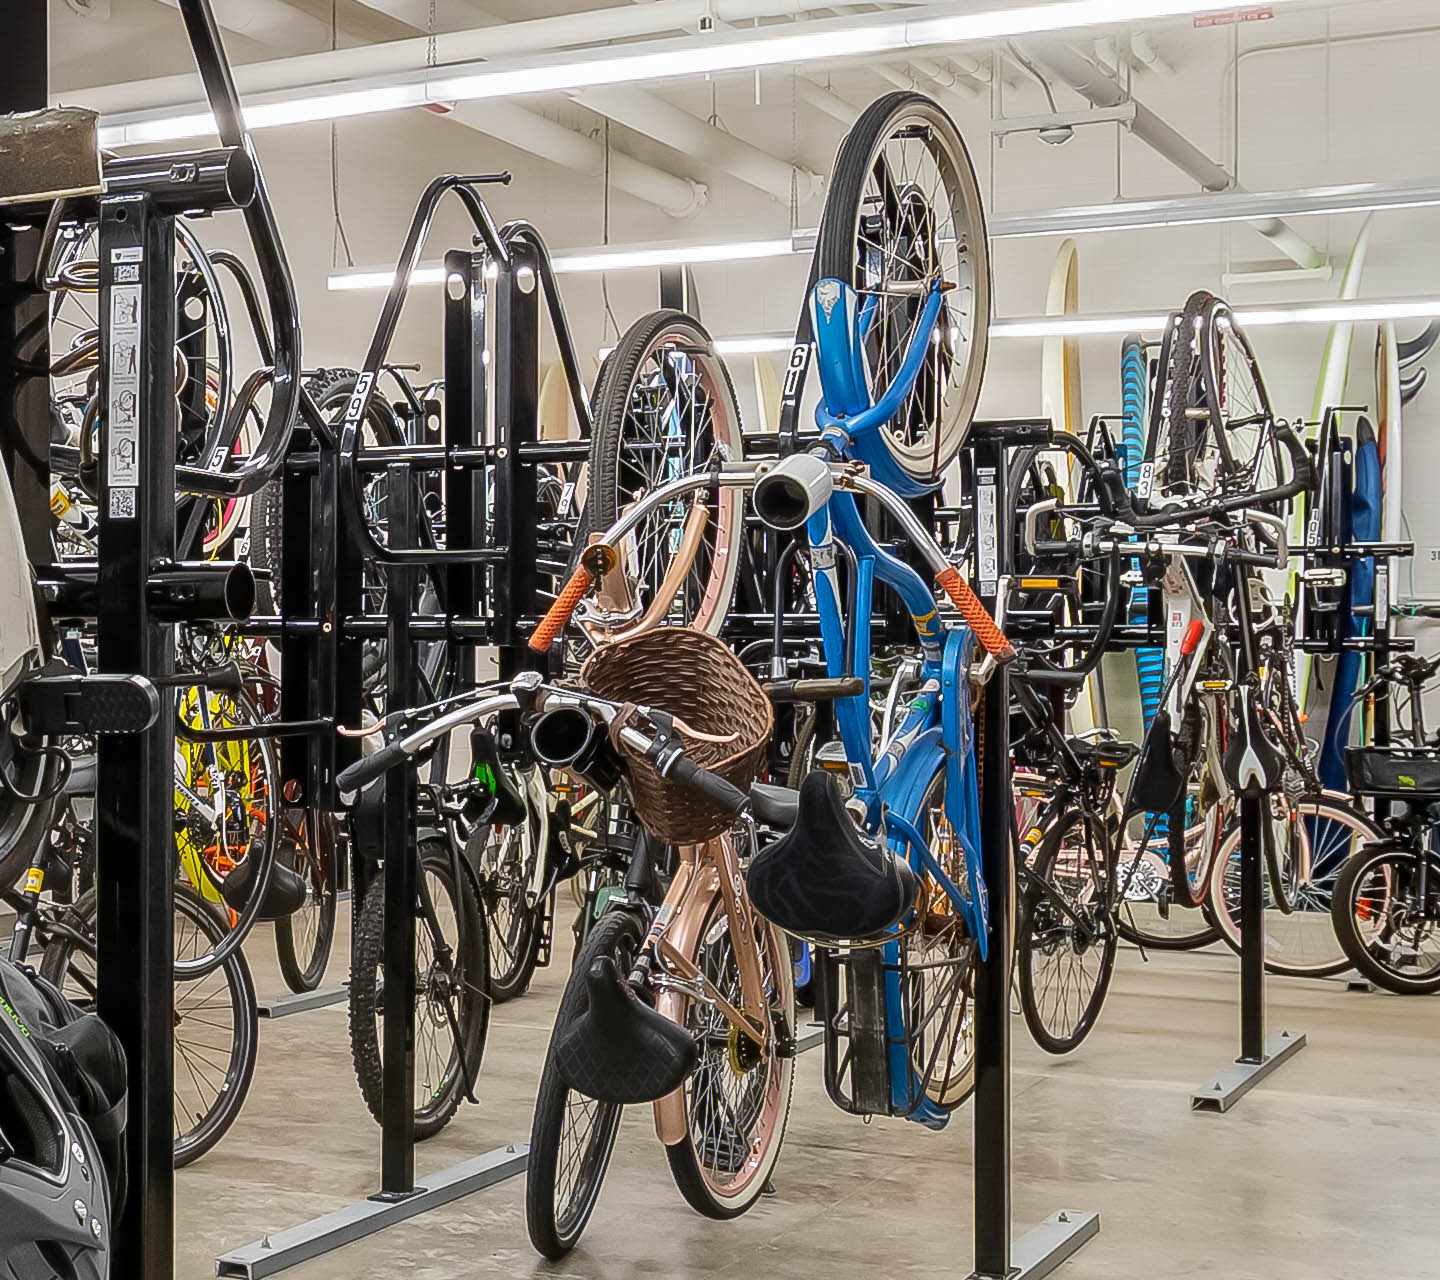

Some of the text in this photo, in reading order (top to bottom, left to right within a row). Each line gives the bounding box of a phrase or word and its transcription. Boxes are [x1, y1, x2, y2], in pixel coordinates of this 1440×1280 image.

[786, 346, 806, 396] 61
[350, 373, 369, 419] 59
[1140, 464, 1152, 496] 83
[560, 483, 574, 512] 79
[1430, 550, 1440, 561] 31
